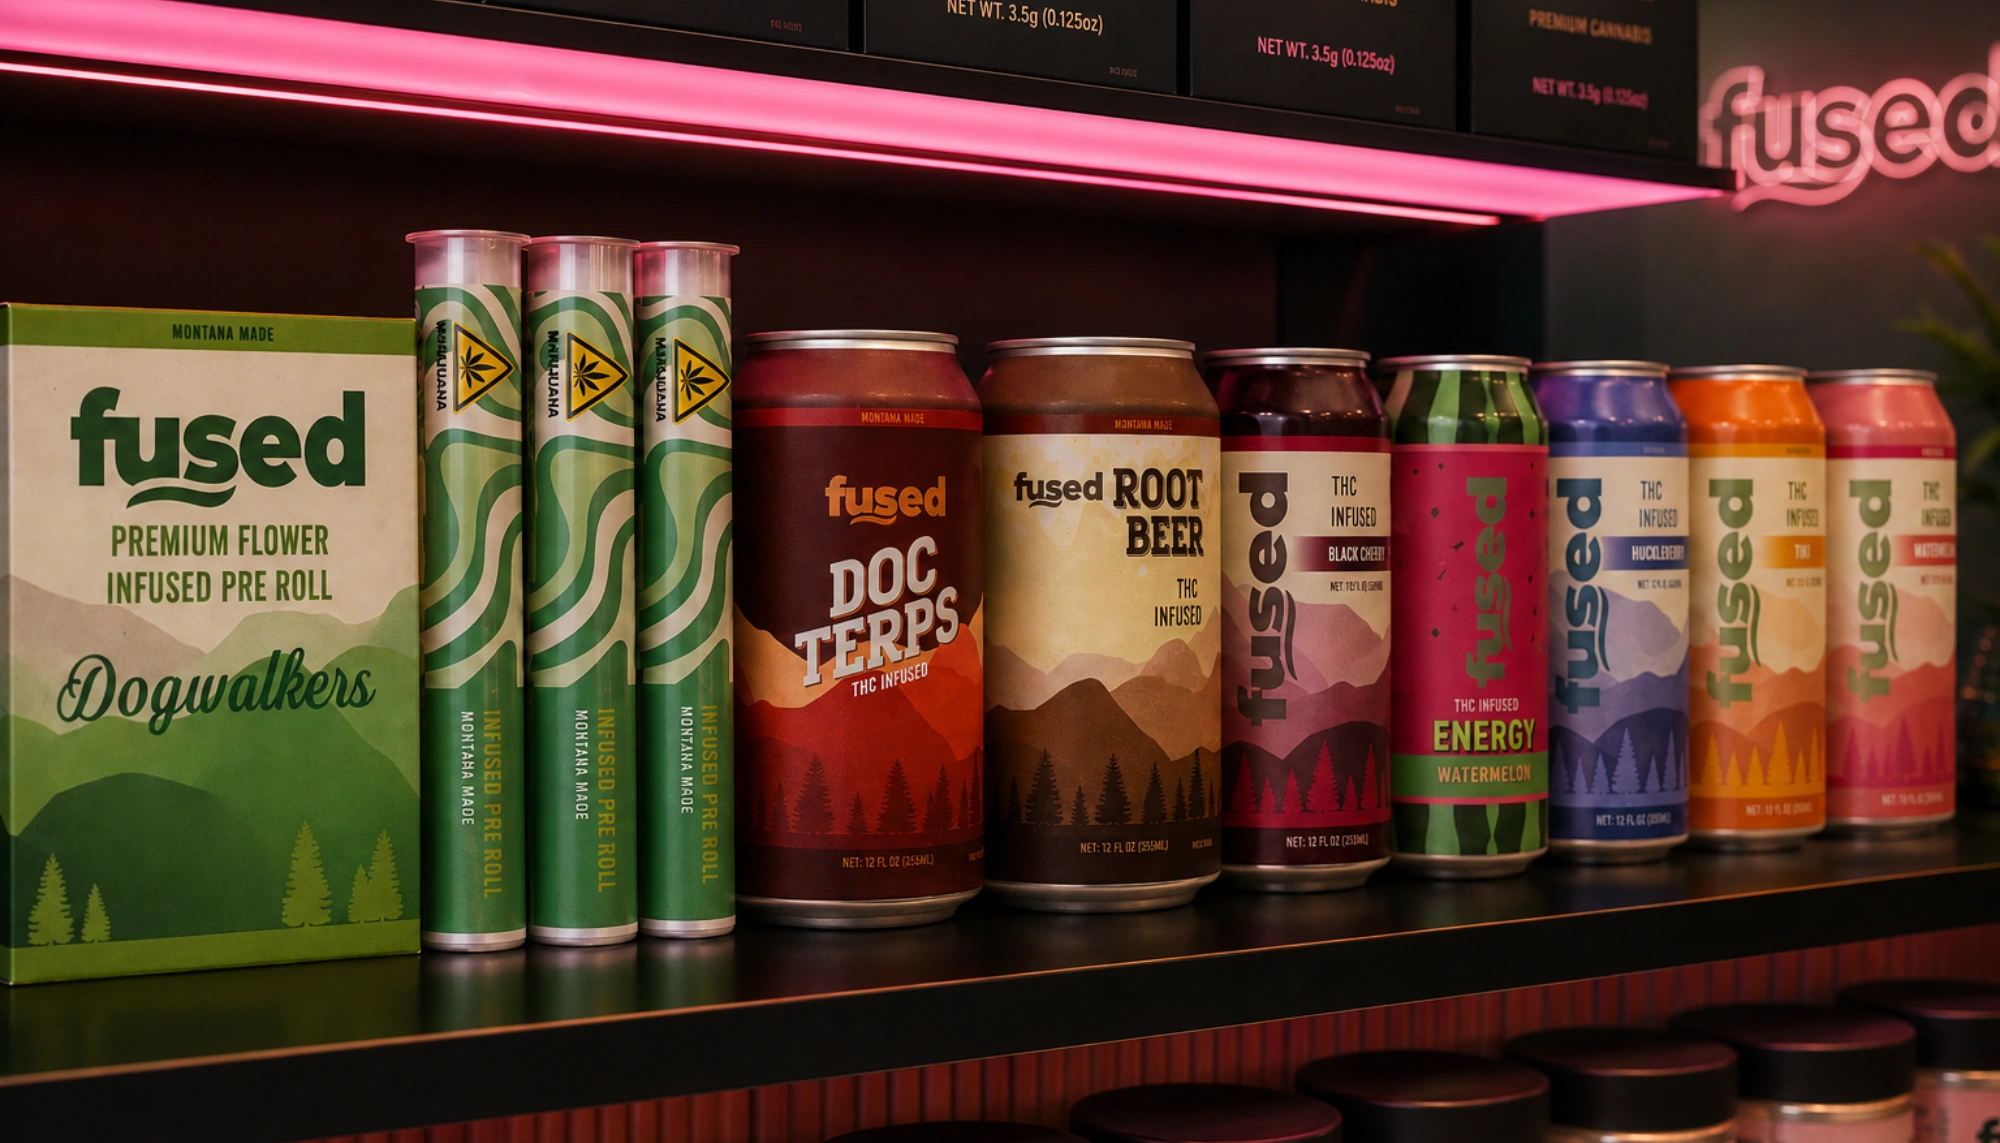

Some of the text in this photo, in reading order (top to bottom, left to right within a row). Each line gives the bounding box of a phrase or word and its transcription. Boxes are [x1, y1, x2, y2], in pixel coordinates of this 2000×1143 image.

[947, 0, 1104, 36] NET WT. 3.5g (0.125oz)
[1528, 8, 1653, 46] PREMIUM CANNABIS
[1257, 36, 1395, 76] NET WT. 3.5g (0.125oz)
[1532, 76, 1555, 95] NET
[172, 323, 275, 342] MONTANA MADE
[70, 386, 366, 508] fused
[825, 475, 946, 526] fused
[1014, 471, 1104, 508] fused
[1113, 467, 1204, 510] ROOT
[1331, 475, 1357, 497] THC
[1640, 480, 1662, 500] THC
[1788, 481, 1807, 501] THC
[1330, 506, 1377, 528] INFUSED
[1639, 508, 1678, 528] INFUSED
[112, 525, 330, 557] PREMIUM FLOWER
[1125, 515, 1205, 557] BEER
[1328, 546, 1359, 562] BLACK
[107, 569, 333, 604] INFUSED PRE ROLL
[829, 535, 938, 619] DOC
[1176, 578, 1198, 599] THC
[1466, 477, 1513, 688] fused
[1706, 478, 1761, 709] fused
[1847, 479, 1898, 703] fused
[1237, 472, 1298, 726] fused
[1555, 478, 1610, 714] fused
[1154, 605, 1202, 627] INFUSED
[794, 586, 960, 688] TERPS
[57, 647, 376, 736] Dogwalkers
[851, 662, 929, 698] THC INFUSED
[1454, 698, 1519, 713] THC INFUSED
[1433, 718, 1536, 752] ENERGY
[1437, 764, 1532, 783] WATERMELON
[483, 710, 502, 899] INFUSED PRE ROLL
[597, 708, 616, 893] INFUSED PRE ROLL
[702, 704, 719, 884] INFUSED PRE ROLL
[1080, 841, 1100, 854] NET:
[1102, 842, 1112, 854] 12
[1113, 842, 1124, 853] FL
[1125, 841, 1136, 853] OZ
[1286, 836, 1306, 848] NET:
[1308, 836, 1317, 848] 12
[1318, 836, 1329, 847] FL
[1330, 834, 1341, 847] OZ
[841, 856, 863, 869] NET:
[865, 857, 875, 868] 12
[877, 856, 888, 868] FL
[889, 856, 900, 867] OZ
